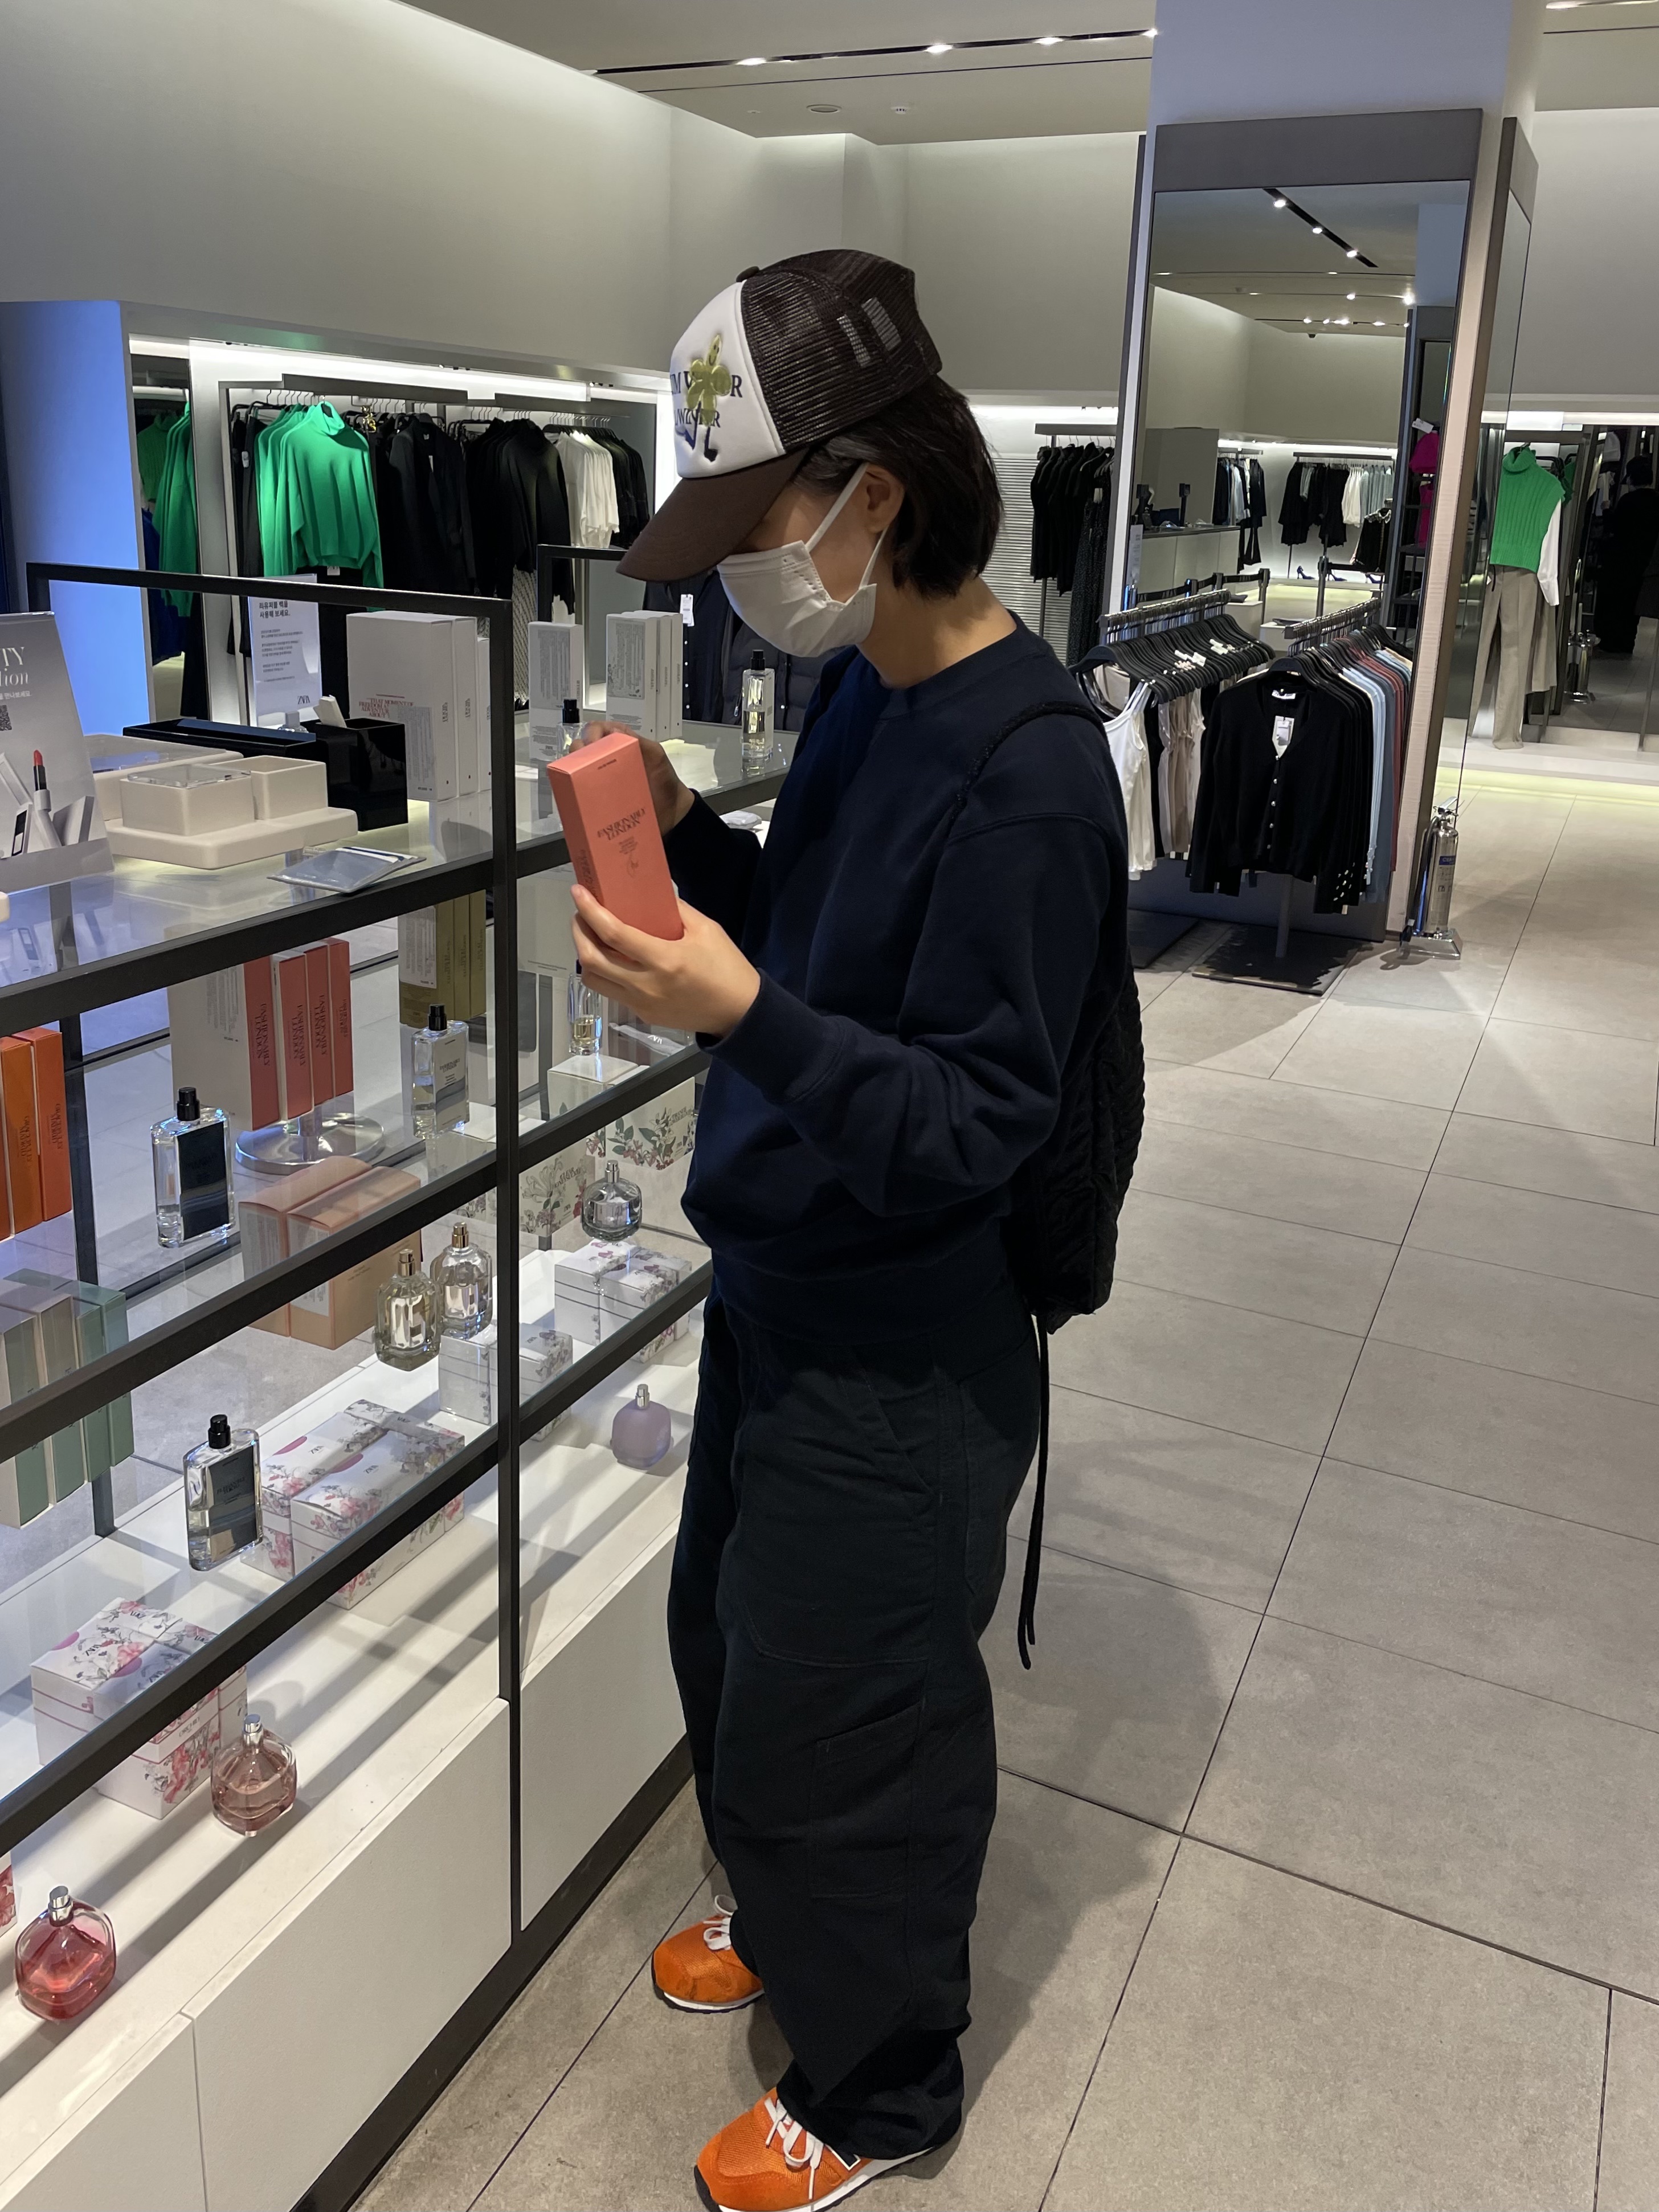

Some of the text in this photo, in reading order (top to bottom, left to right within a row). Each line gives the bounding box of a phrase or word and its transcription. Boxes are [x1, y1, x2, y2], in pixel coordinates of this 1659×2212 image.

[261, 1003, 271, 1066] FASHIONABLY
[297, 1004, 307, 1066] FASHIONABLY
[319, 995, 328, 1056] FASHIONABLY
